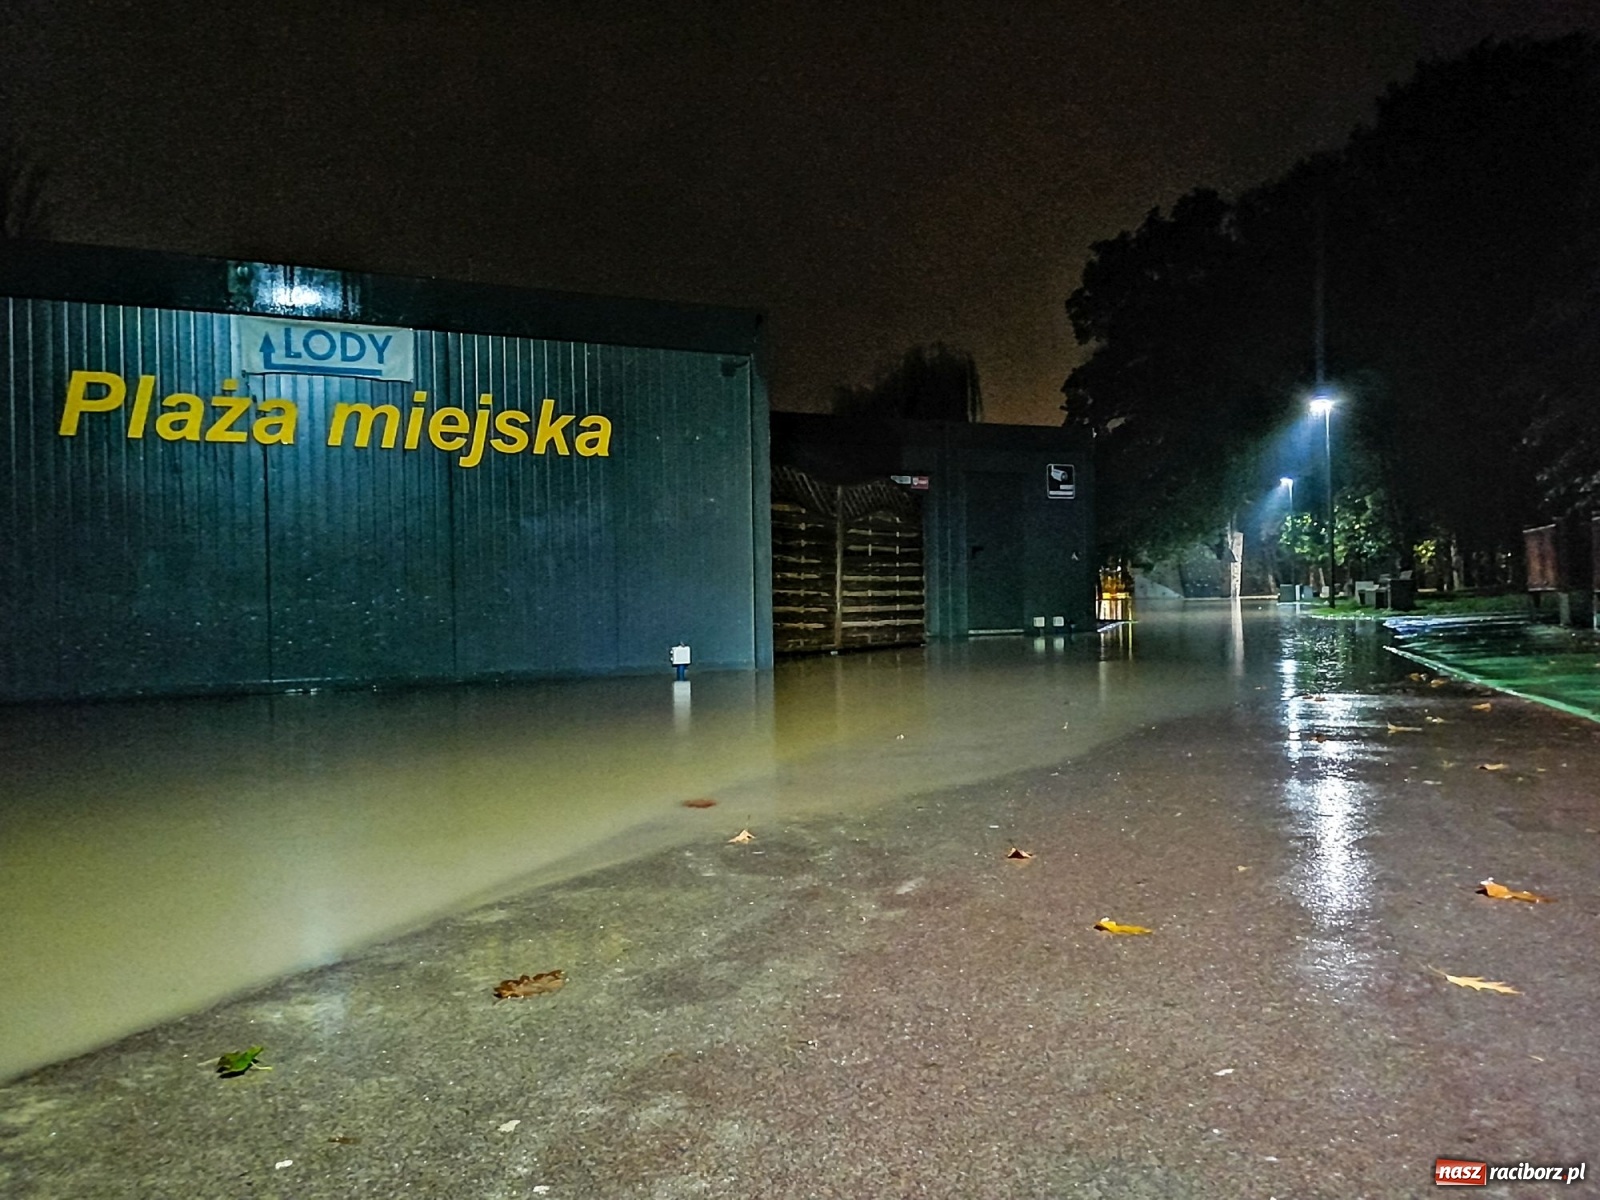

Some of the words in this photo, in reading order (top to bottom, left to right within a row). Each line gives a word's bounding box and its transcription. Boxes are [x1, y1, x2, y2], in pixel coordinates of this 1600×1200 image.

[284, 327, 393, 365] LODY
[58, 369, 298, 445] Plaża
[327, 391, 613, 468] miejska
